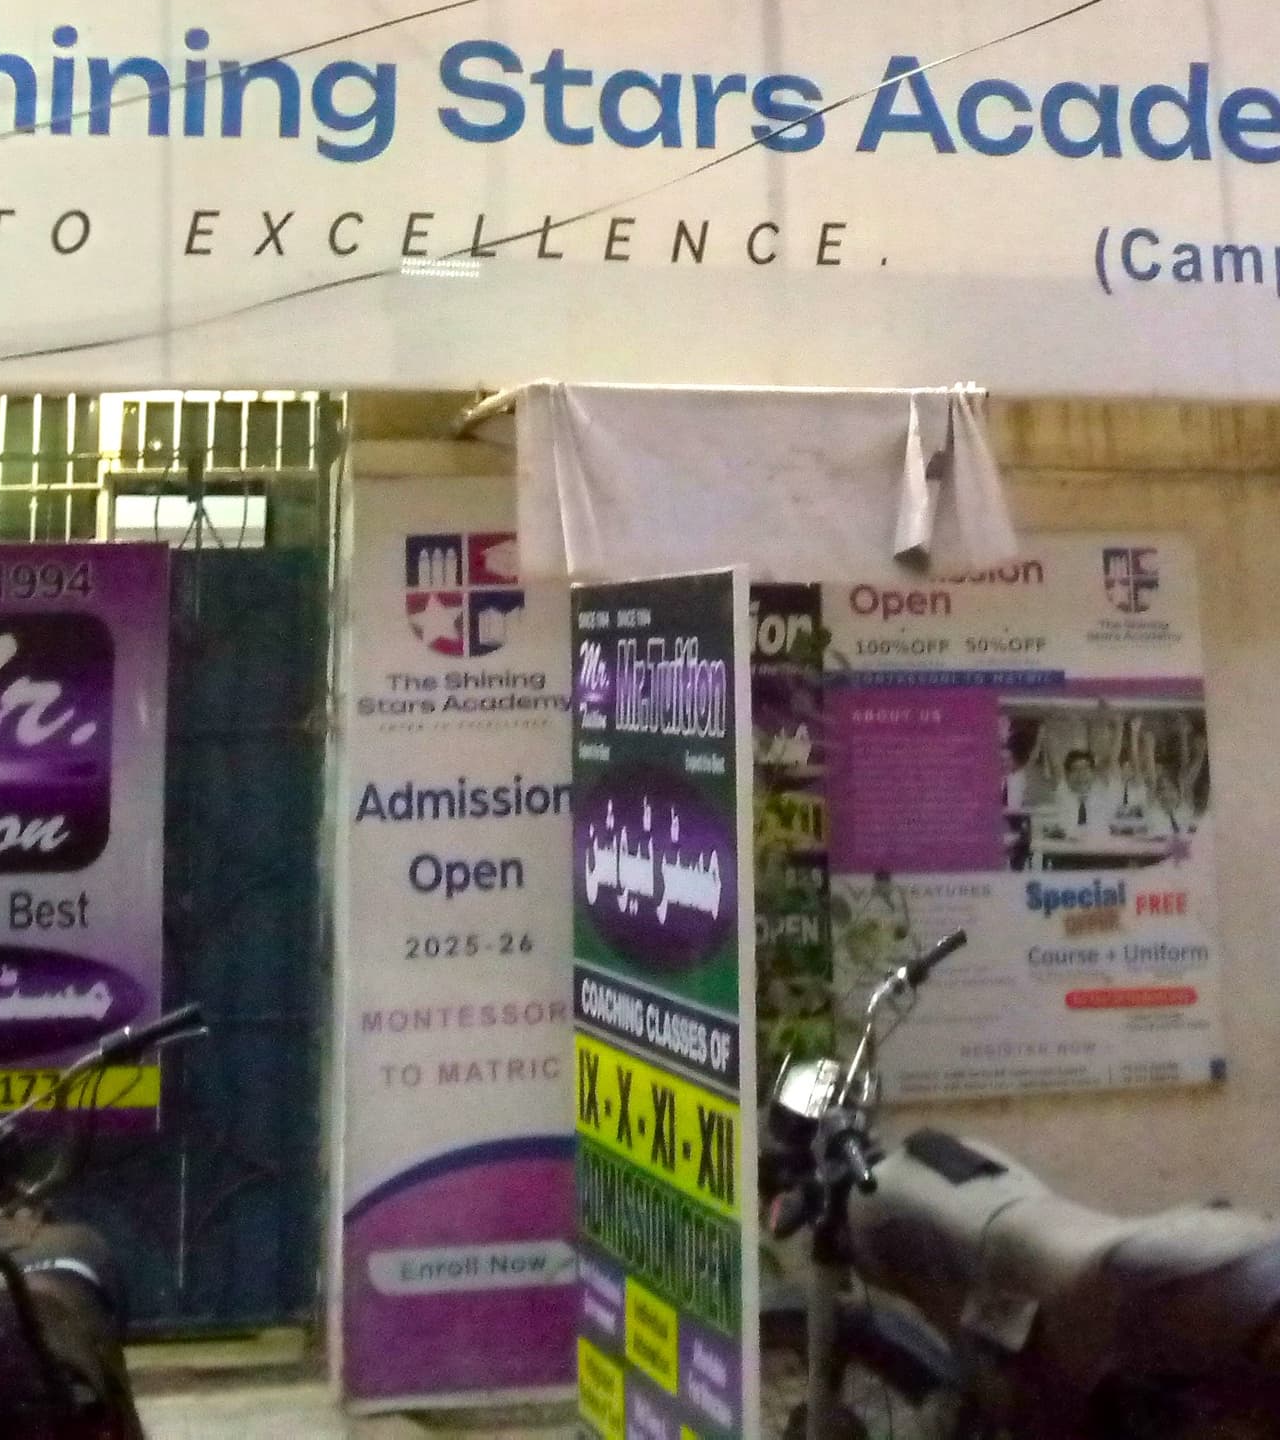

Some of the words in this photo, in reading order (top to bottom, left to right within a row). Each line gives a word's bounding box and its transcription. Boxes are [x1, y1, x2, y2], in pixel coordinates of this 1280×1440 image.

[436, 37, 828, 154] Stars
[181, 208, 891, 270] EXCELLENCE.
[848, 582, 954, 621] Open
[385, 670, 438, 692] The
[444, 668, 547, 692] Shining
[357, 695, 436, 716] Stars
[441, 693, 572, 713] Academy
[355, 774, 575, 824] Admission
[407, 851, 526, 900] Open
[8, 890, 91, 930] Best
[1026, 878, 1126, 919] Special
[1136, 890, 1189, 916] FREE
[1028, 943, 1100, 968] Course
[1123, 942, 1210, 963] Uniform
[359, 999, 571, 1036] MONTESSOR
[581, 977, 644, 1038] COACHING
[646, 1003, 708, 1065] CLASSES
[710, 1027, 731, 1073] OF
[379, 1062, 422, 1090] TO
[436, 1055, 562, 1087] MATRIC
[398, 1252, 481, 1282] Enroll
[488, 1250, 549, 1277] Now
